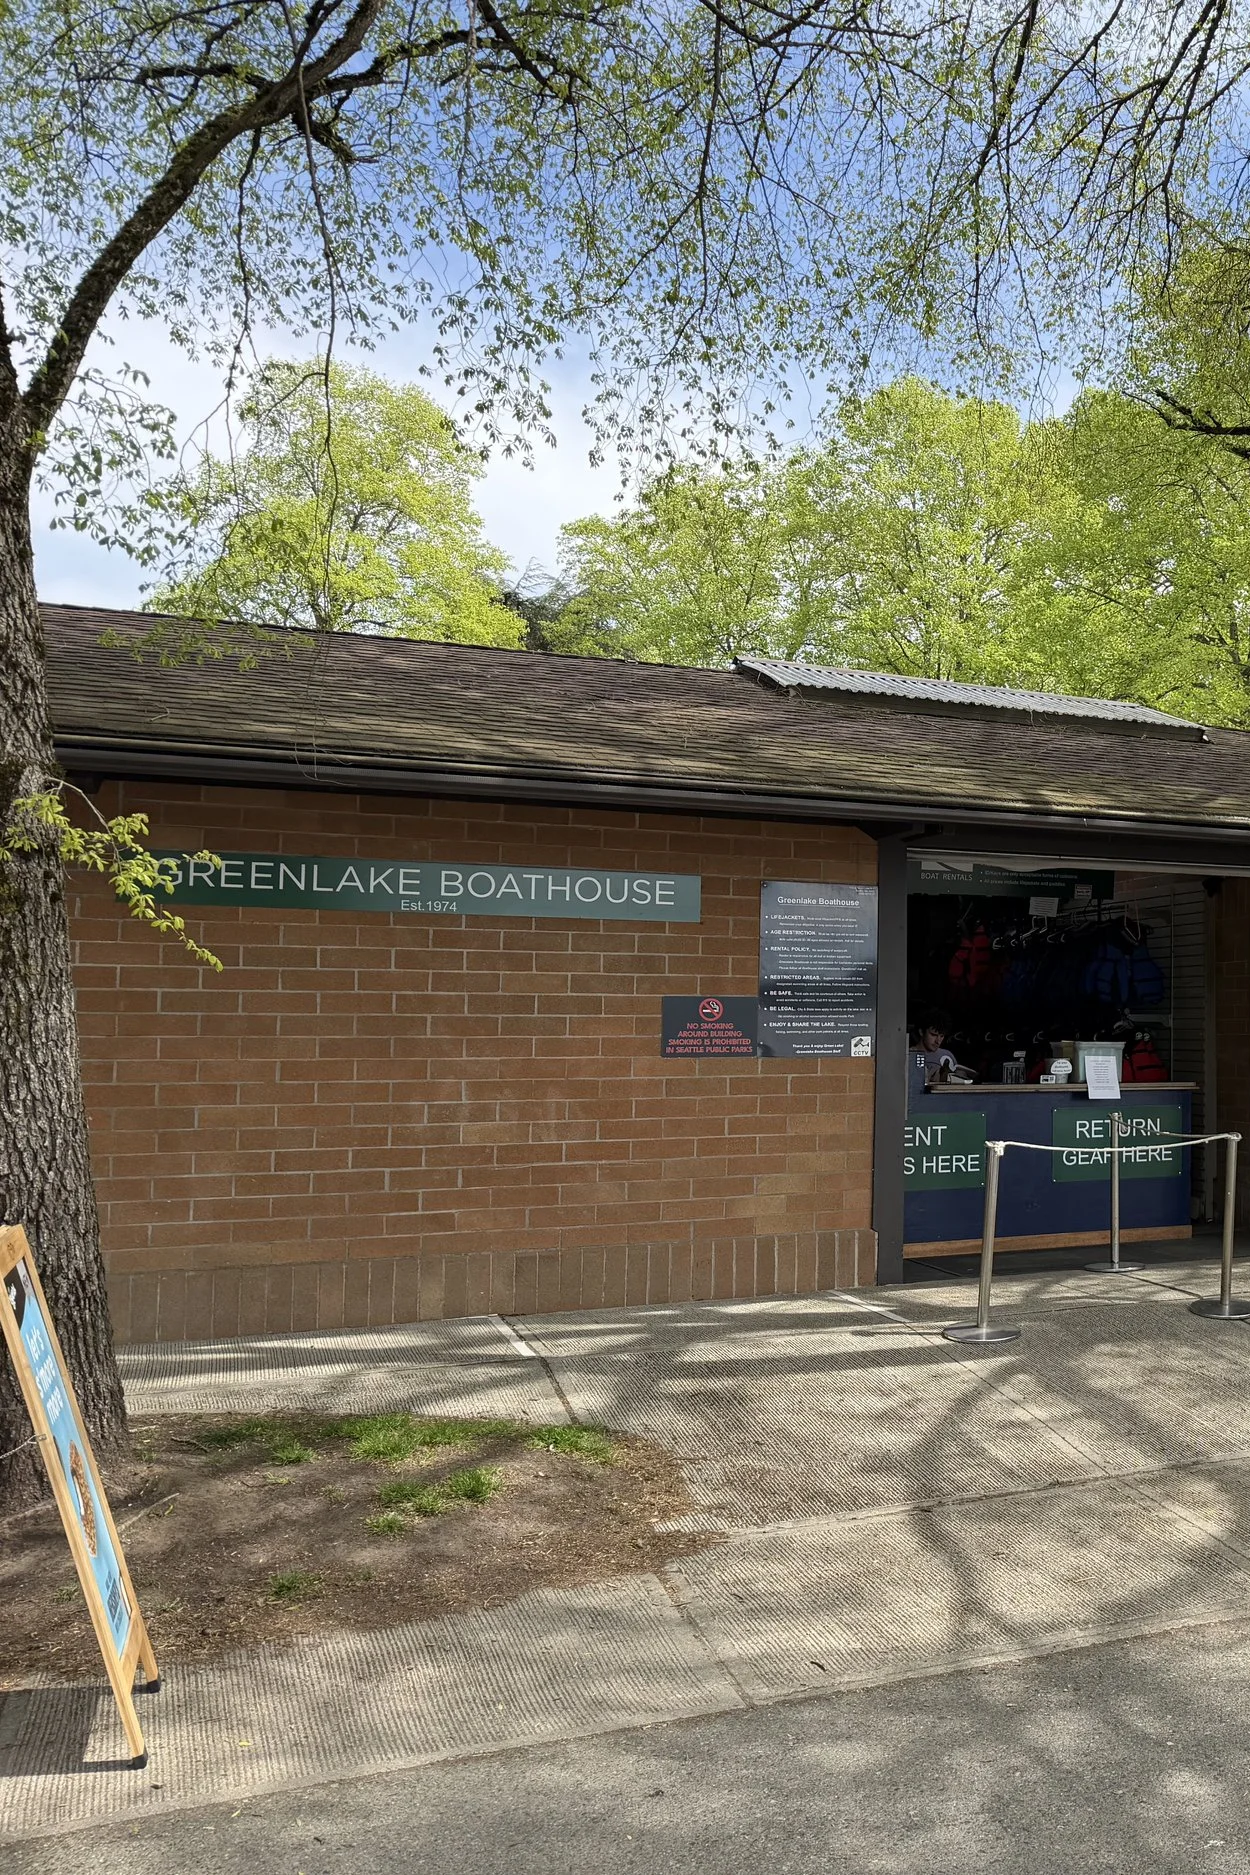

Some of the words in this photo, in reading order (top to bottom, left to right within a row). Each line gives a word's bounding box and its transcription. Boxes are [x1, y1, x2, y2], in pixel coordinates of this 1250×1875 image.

[155, 857, 421, 896] GREENLAKE
[440, 869, 675, 906] BOATHOUSE
[920, 872, 939, 880] BOAT
[943, 873, 973, 881] RENTALS
[777, 896, 817, 905] Greenlake
[818, 897, 860, 907] Boathouse
[686, 1022, 699, 1030] NO
[700, 1022, 734, 1030] SMOKING
[1076, 1118, 1160, 1139] RETURN
[1122, 1146, 1173, 1163] HERE
[923, 1154, 980, 1174] HERE
